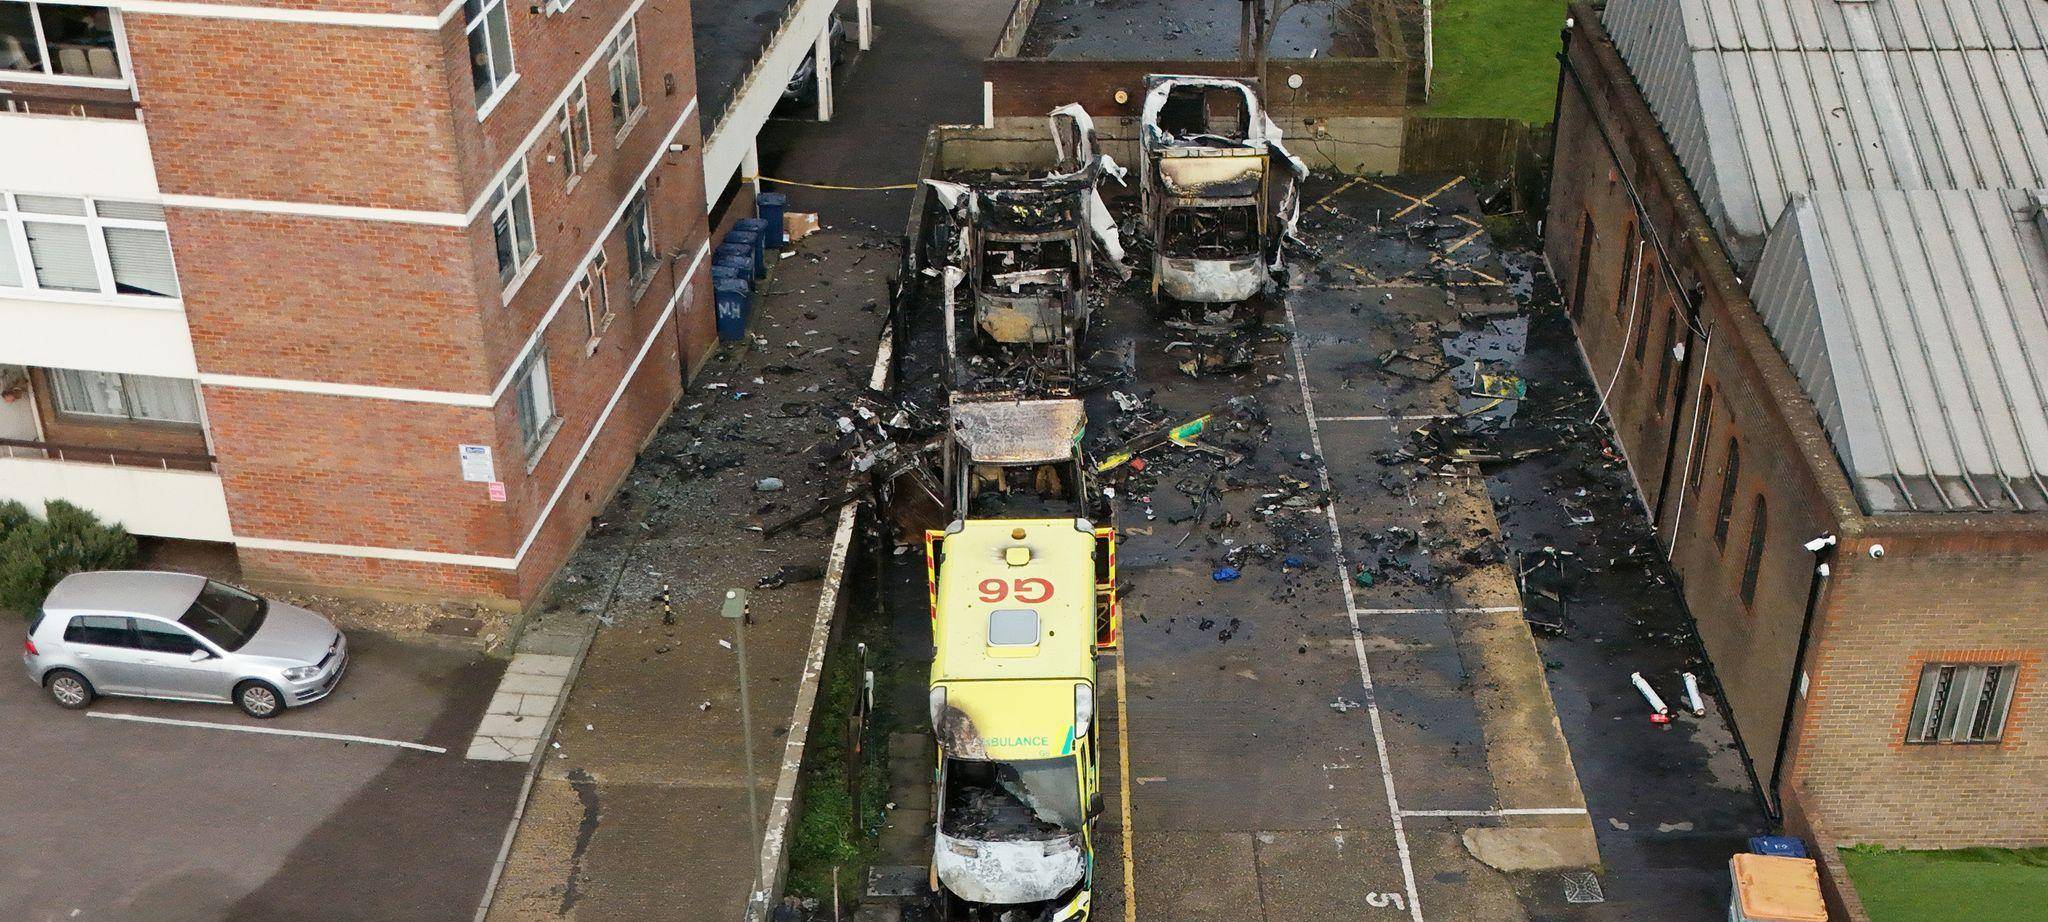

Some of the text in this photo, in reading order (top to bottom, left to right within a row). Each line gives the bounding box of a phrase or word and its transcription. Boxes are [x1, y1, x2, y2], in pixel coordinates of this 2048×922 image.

[978, 577, 1054, 602] G6
[977, 736, 1048, 747] MBULANCE
[1365, 891, 1405, 911] 5
